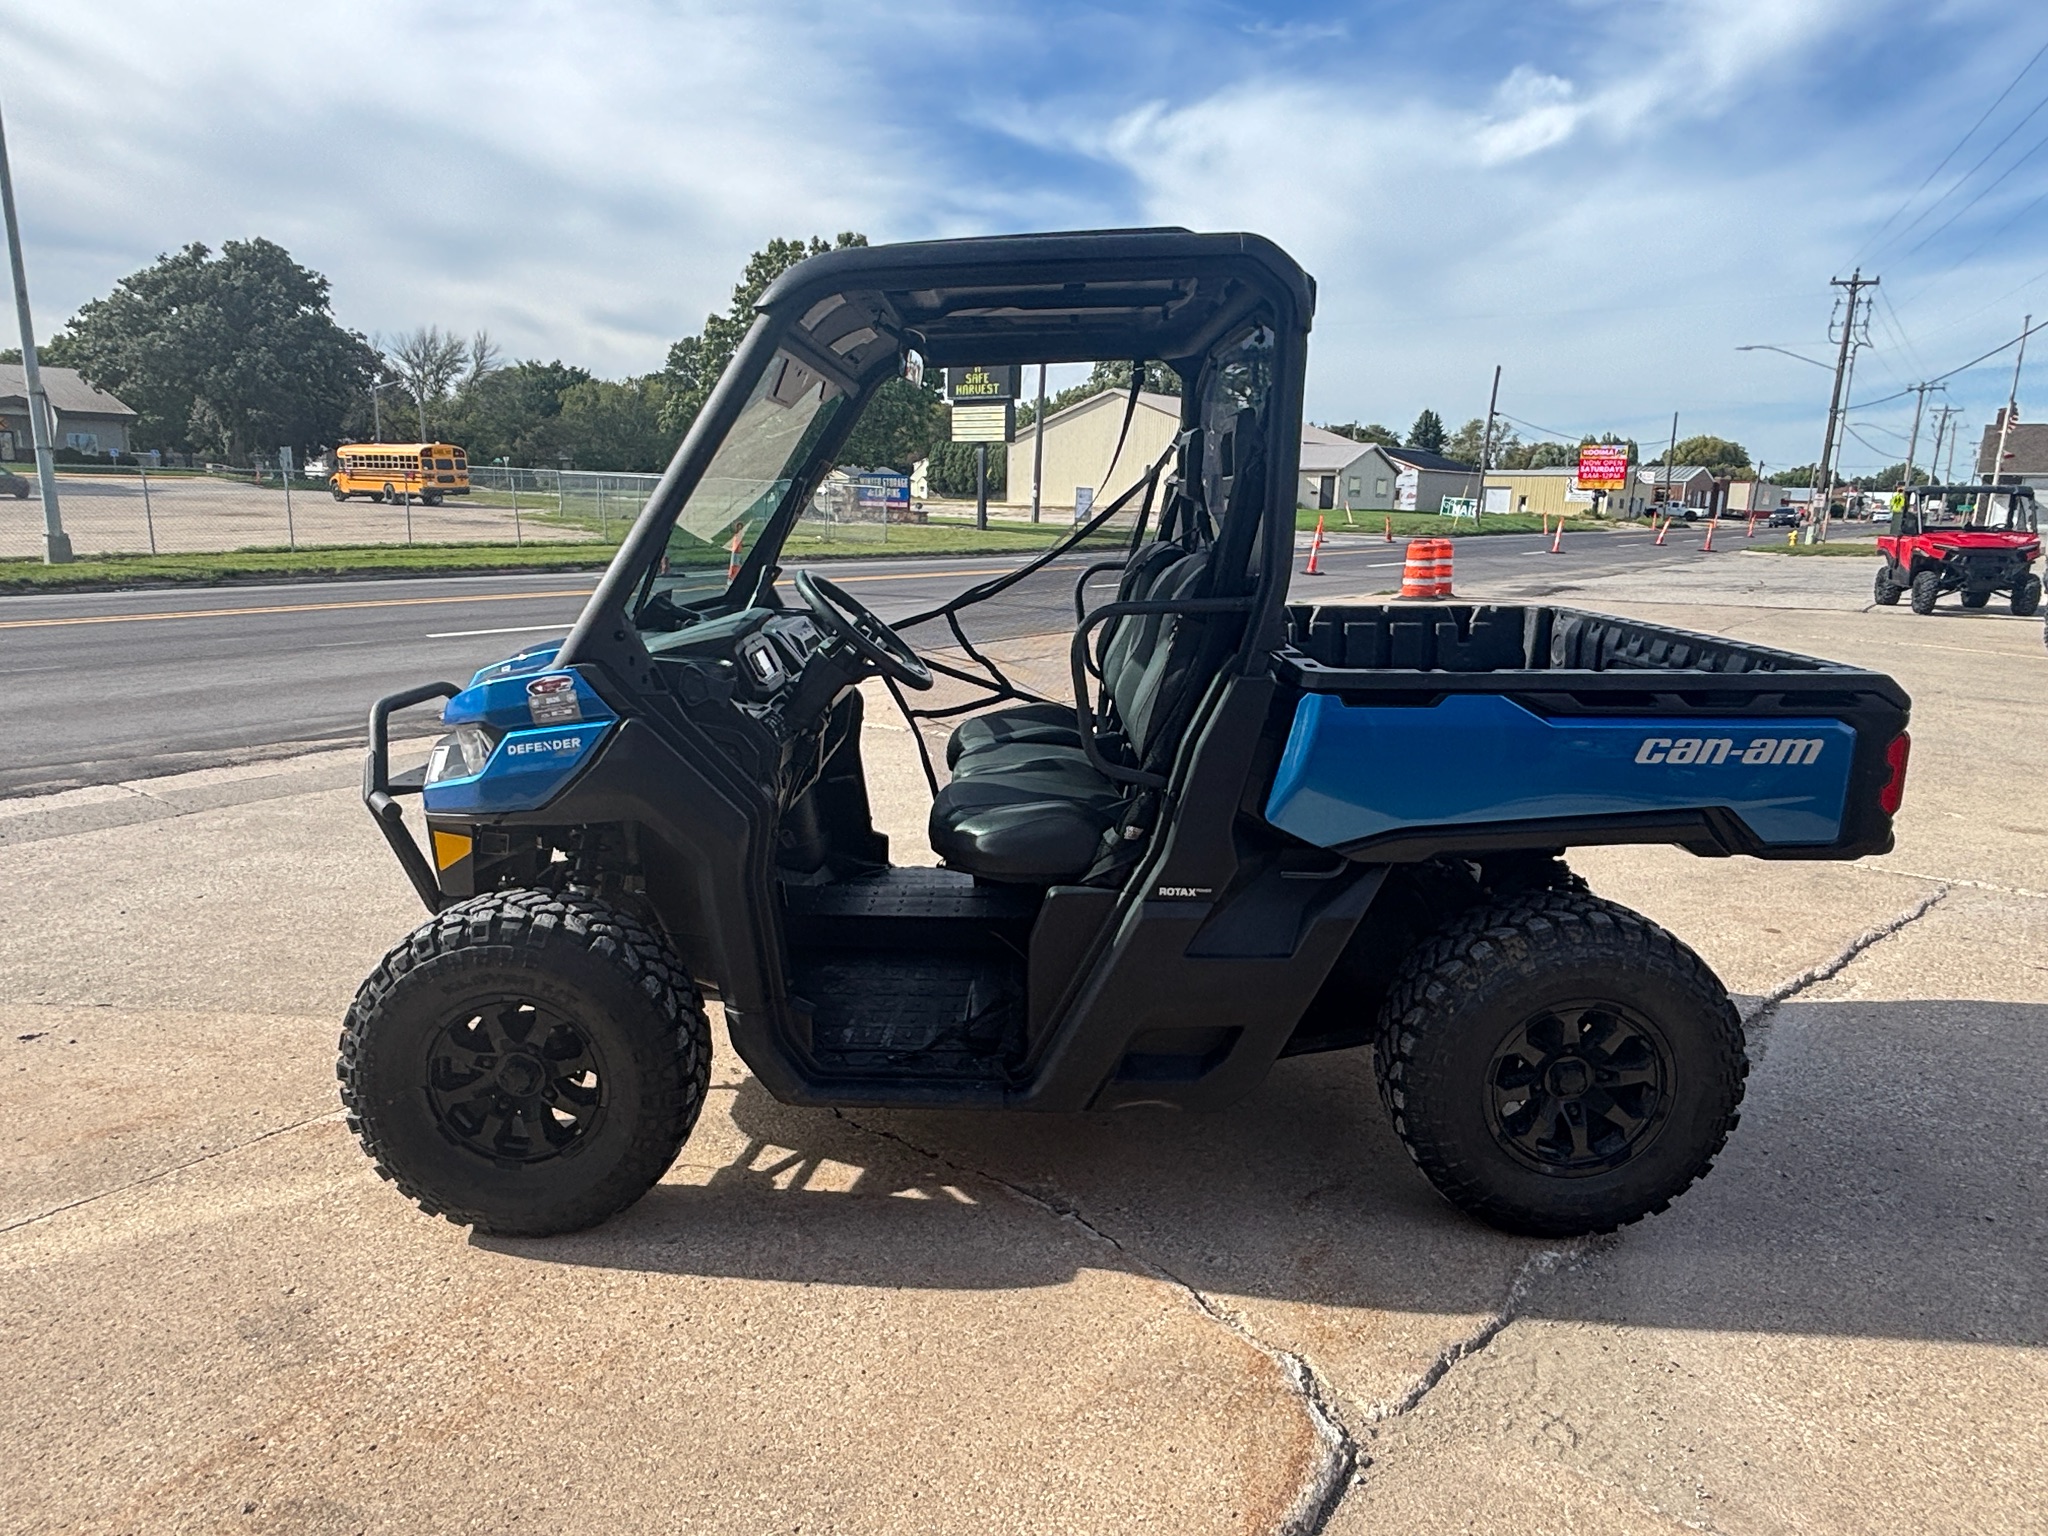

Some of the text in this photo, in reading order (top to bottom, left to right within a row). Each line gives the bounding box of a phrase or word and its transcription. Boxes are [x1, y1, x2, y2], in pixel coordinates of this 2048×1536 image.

[965, 372, 990, 384] SAFE
[955, 383, 1000, 395] HARVEST
[507, 738, 580, 755] DEFENDER
[1634, 738, 1825, 765] can-am
[1158, 887, 1197, 897] ROTAX
